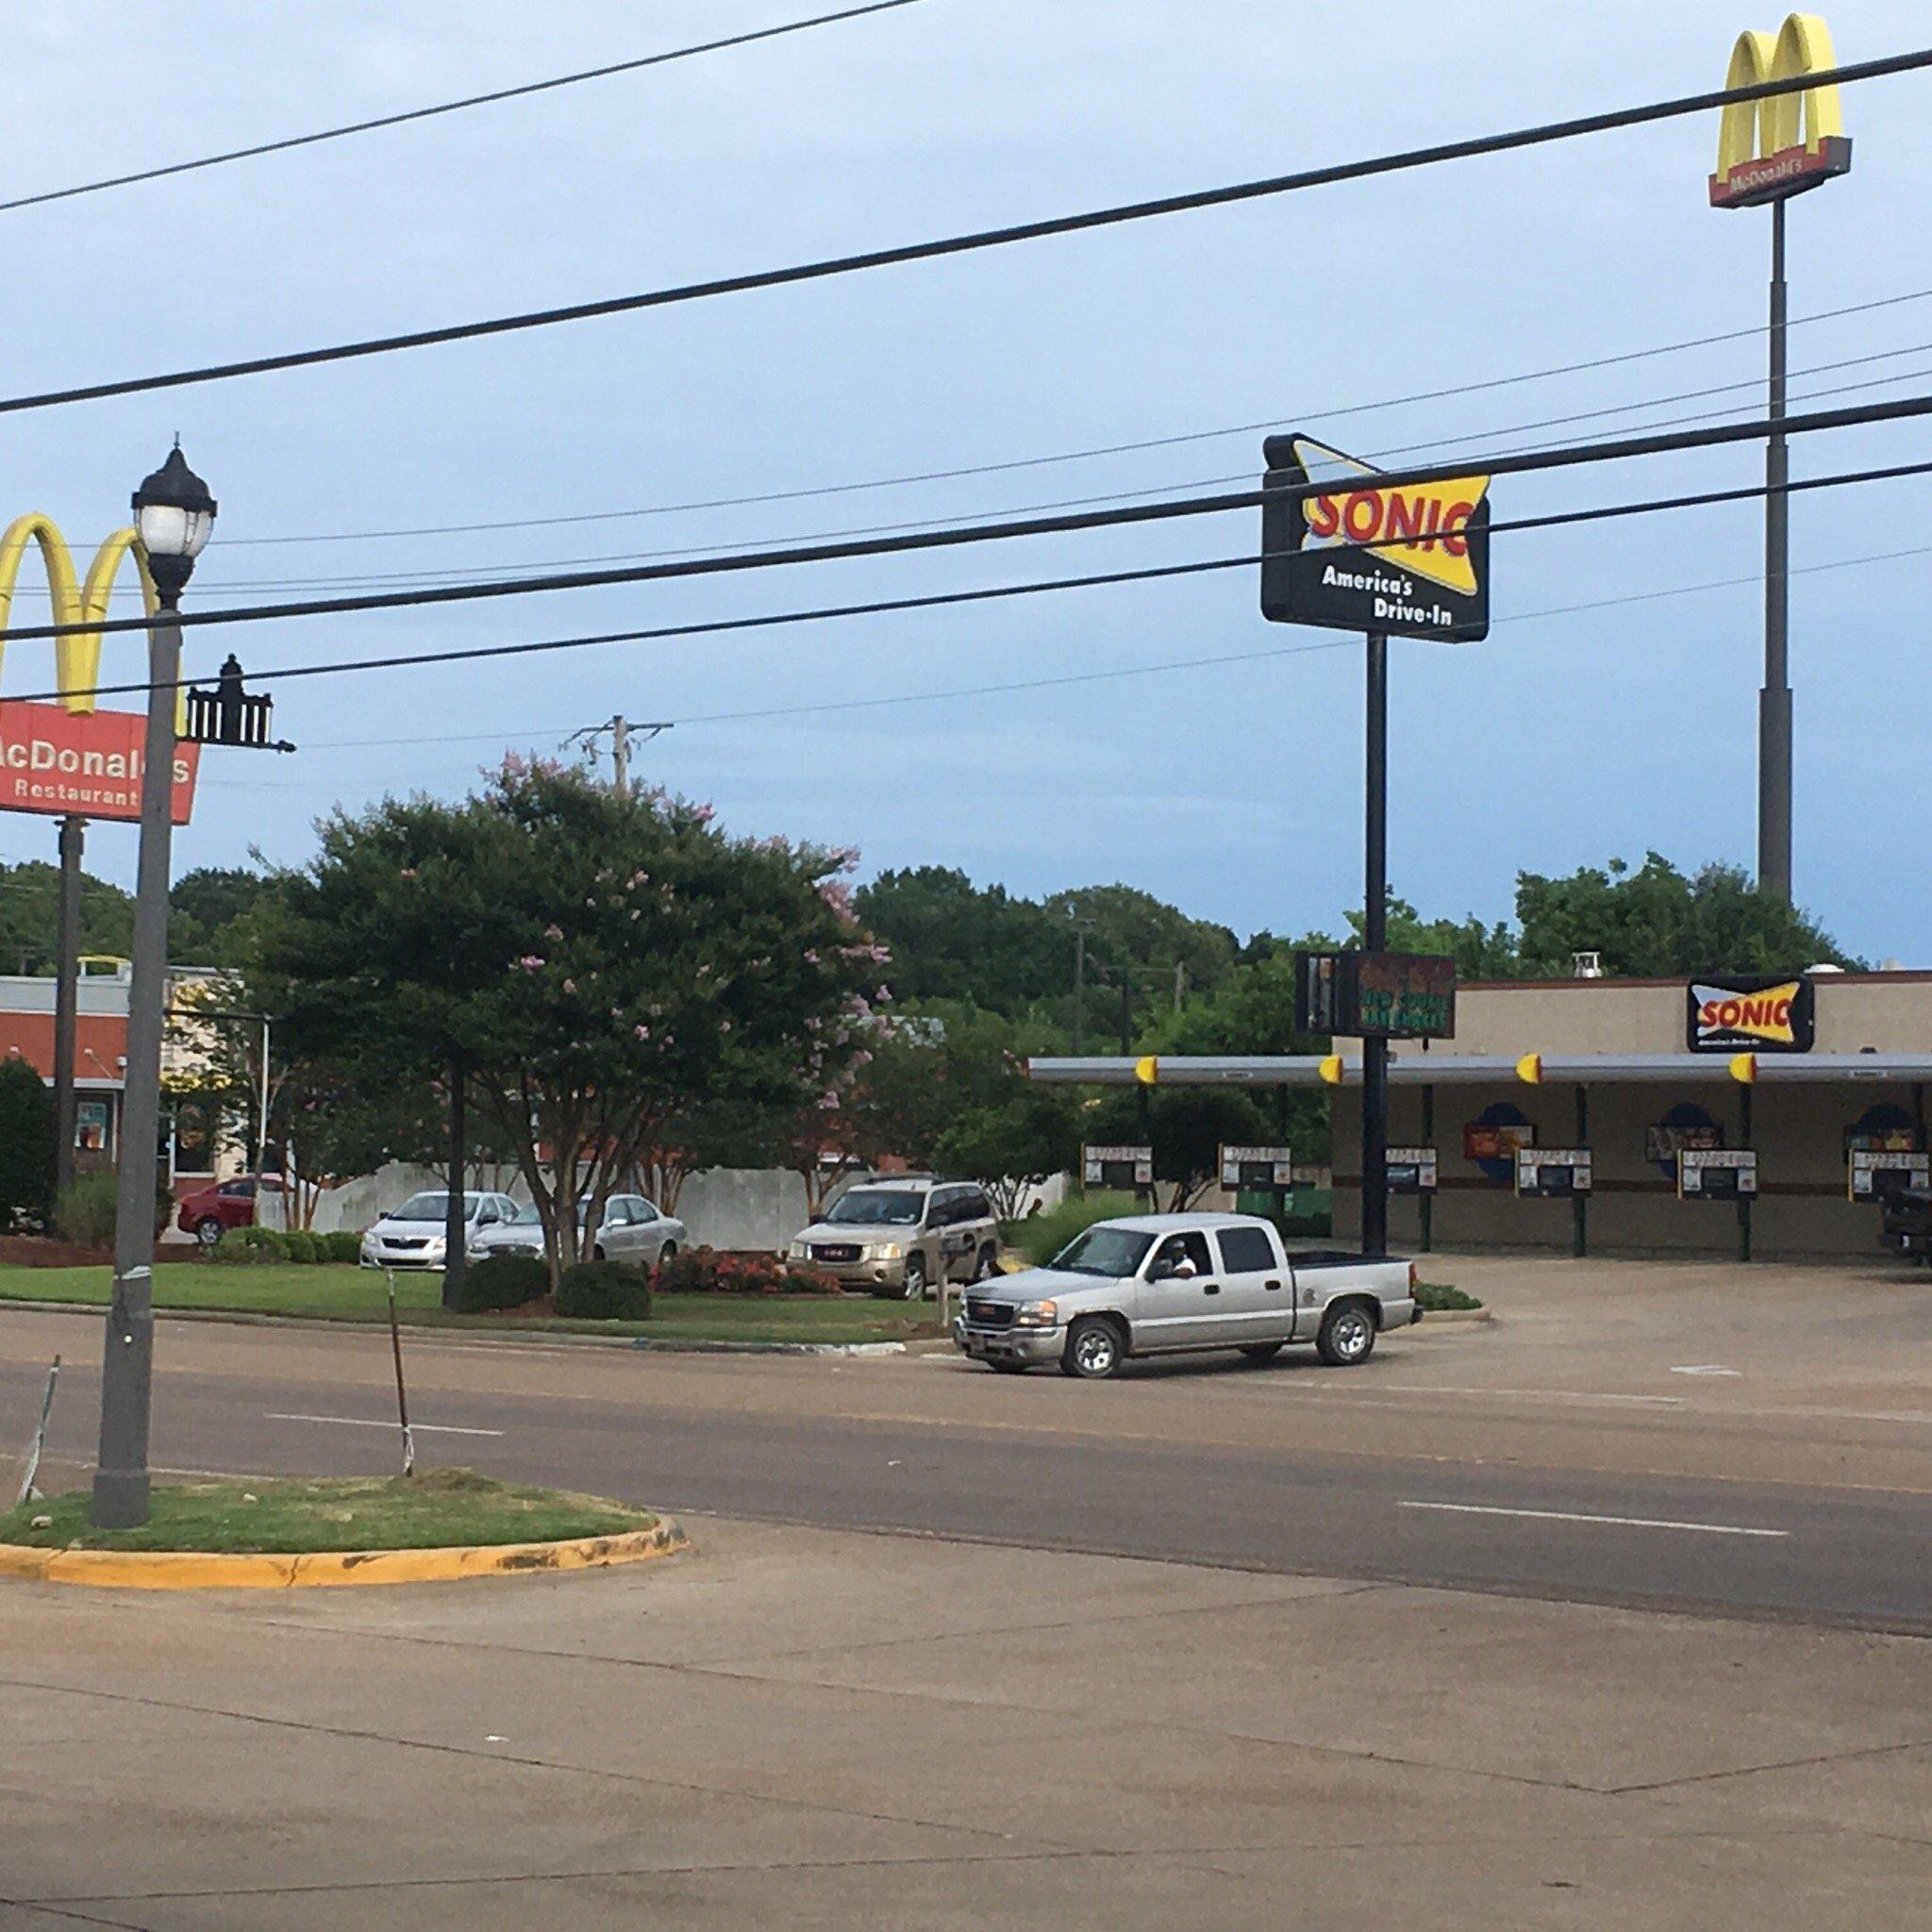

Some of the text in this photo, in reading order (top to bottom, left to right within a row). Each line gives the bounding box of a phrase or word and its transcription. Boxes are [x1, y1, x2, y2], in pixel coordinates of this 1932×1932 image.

[1307, 489, 1474, 557] SONIC
[1322, 565, 1413, 597] America's
[1374, 597, 1453, 625] Drive-In
[0, 736, 190, 784] cDonals
[14, 778, 139, 807] Restaurant
[1699, 997, 1793, 1027] SONIC
